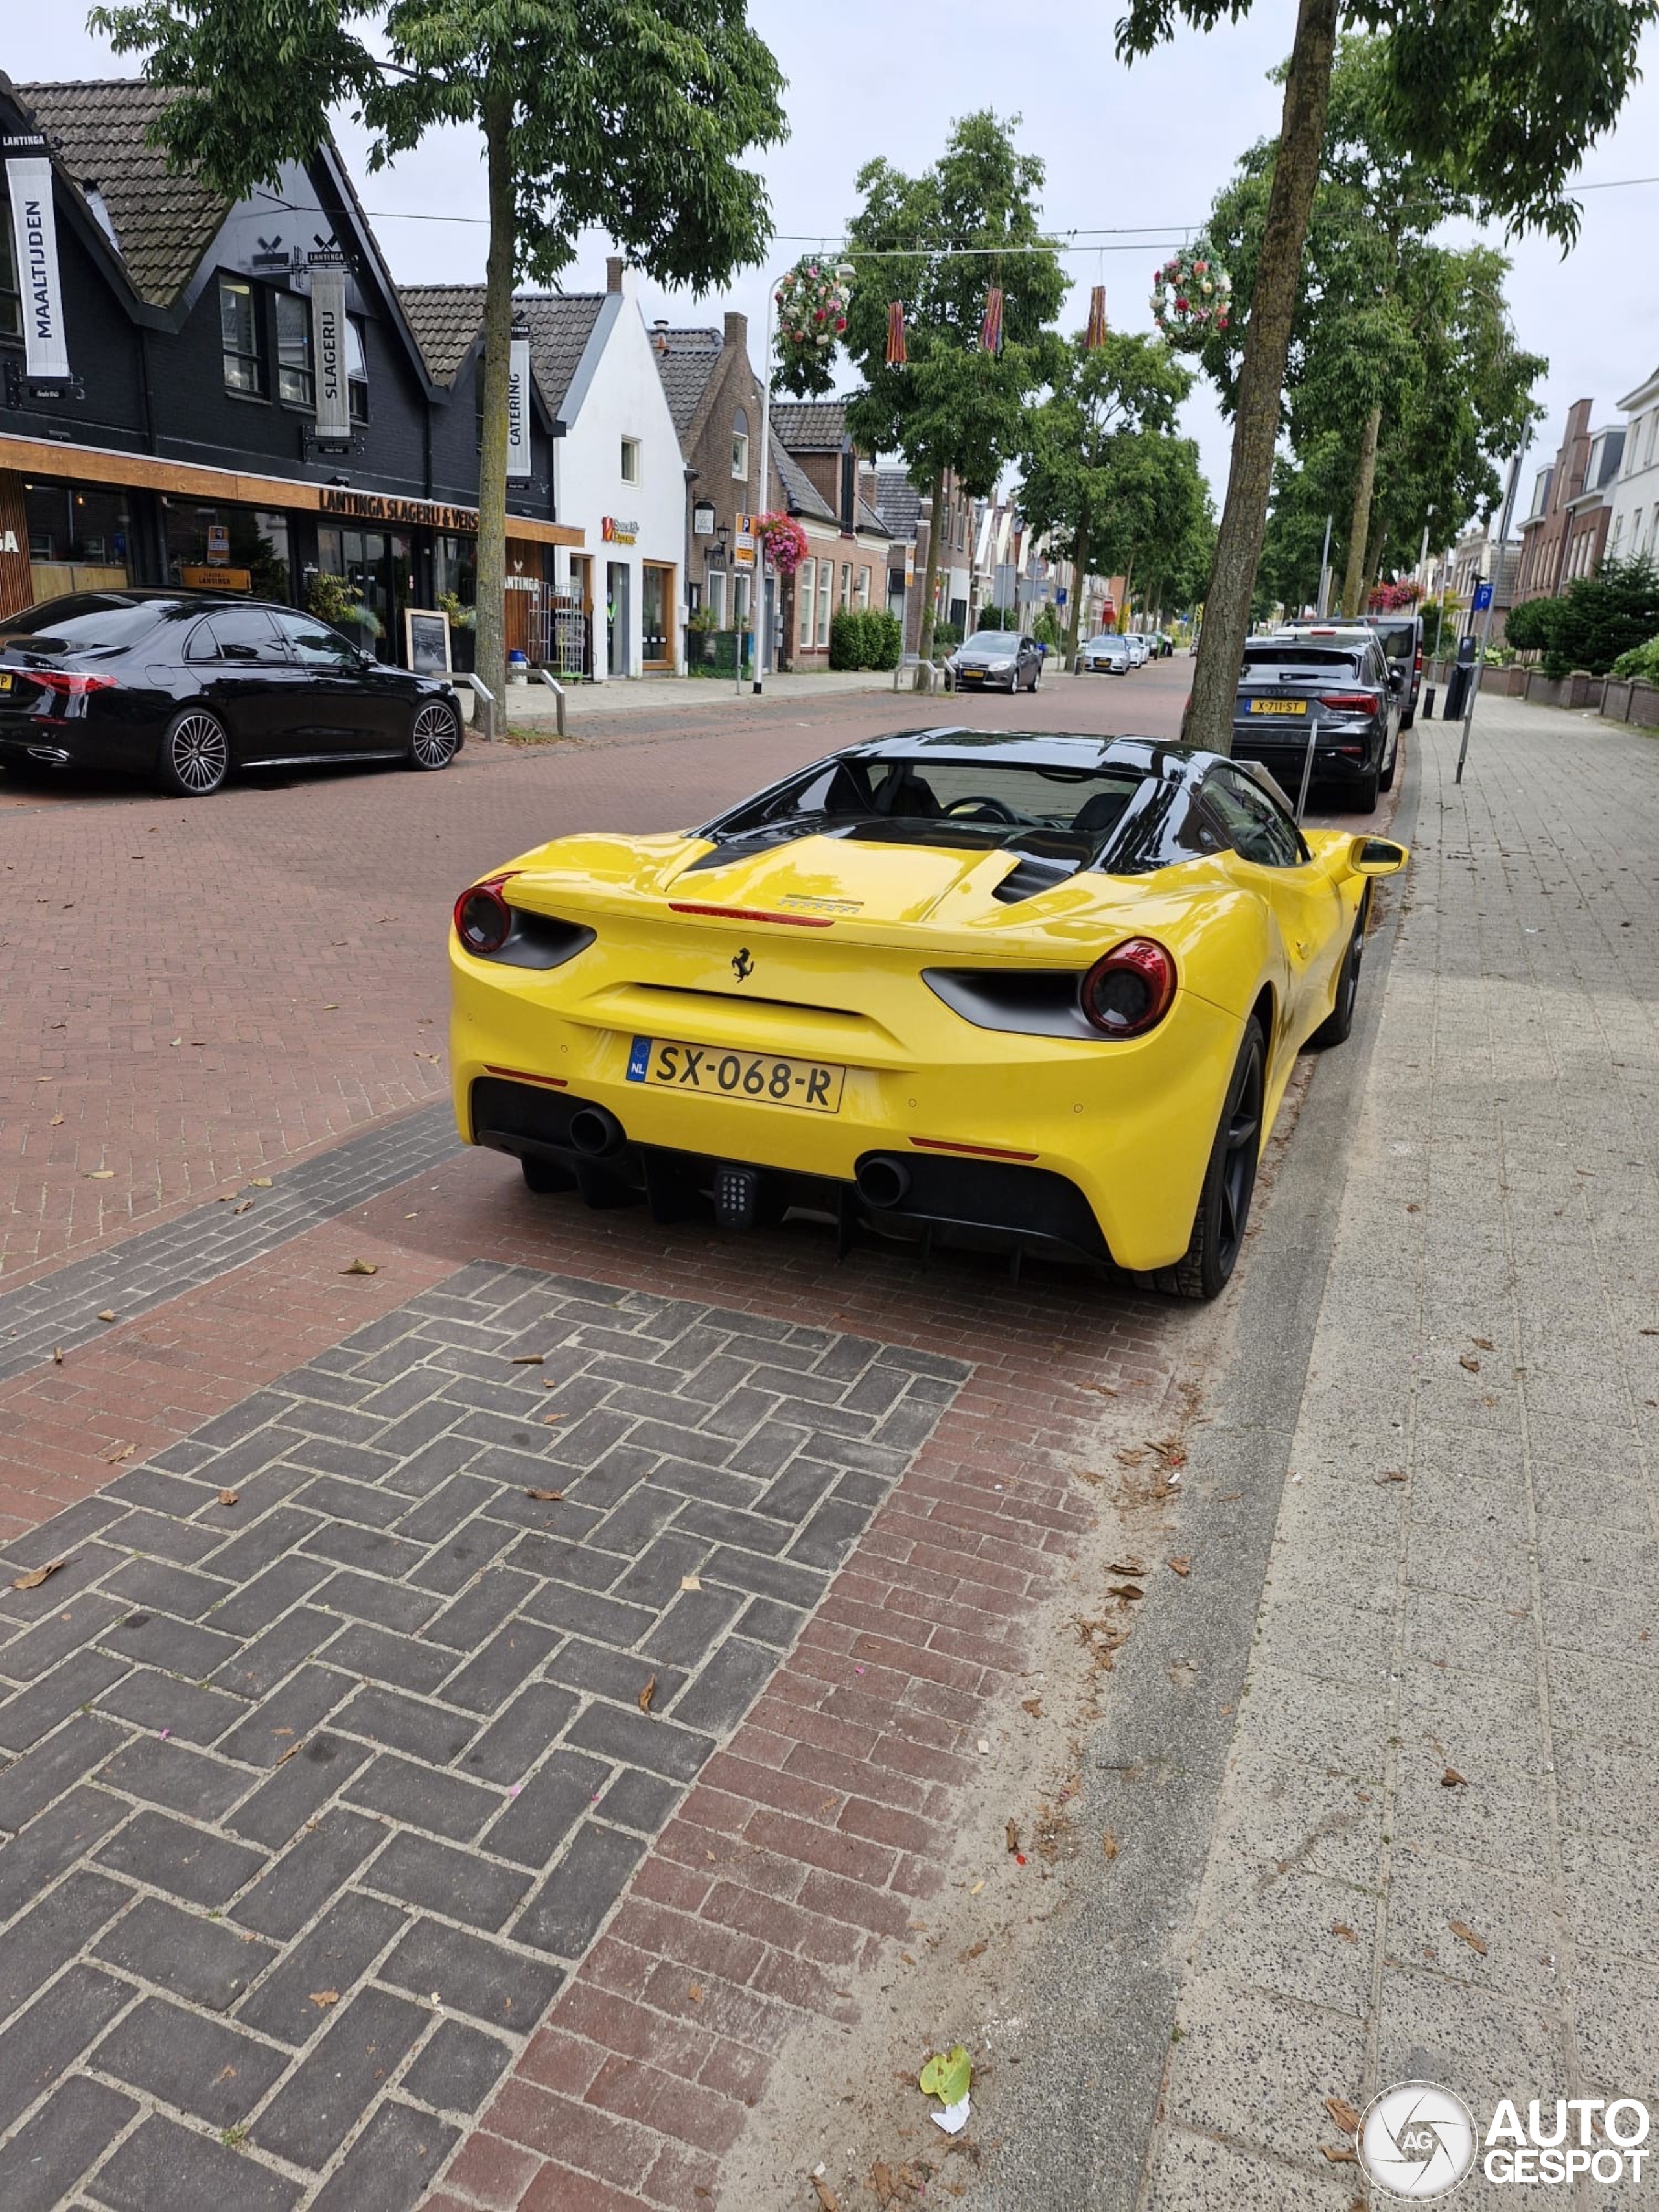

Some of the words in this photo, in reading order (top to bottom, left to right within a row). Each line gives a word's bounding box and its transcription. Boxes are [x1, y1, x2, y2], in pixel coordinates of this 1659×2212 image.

[3, 135, 45, 146] LANTINGA
[25, 201, 52, 338] MAALTIJDEN
[310, 253, 343, 261] LANTINGA
[322, 311, 338, 399] SLAGERIJ
[509, 373, 521, 446] CATERING
[319, 489, 386, 518] LANTINGA
[386, 499, 441, 525] SLAGERIJ
[442, 509, 450, 526] &
[1480, 590, 1489, 603] P
[1258, 702, 1300, 712] X-711-ST
[631, 1062, 645, 1075] NL
[656, 1046, 831, 1106] SX-068-R
